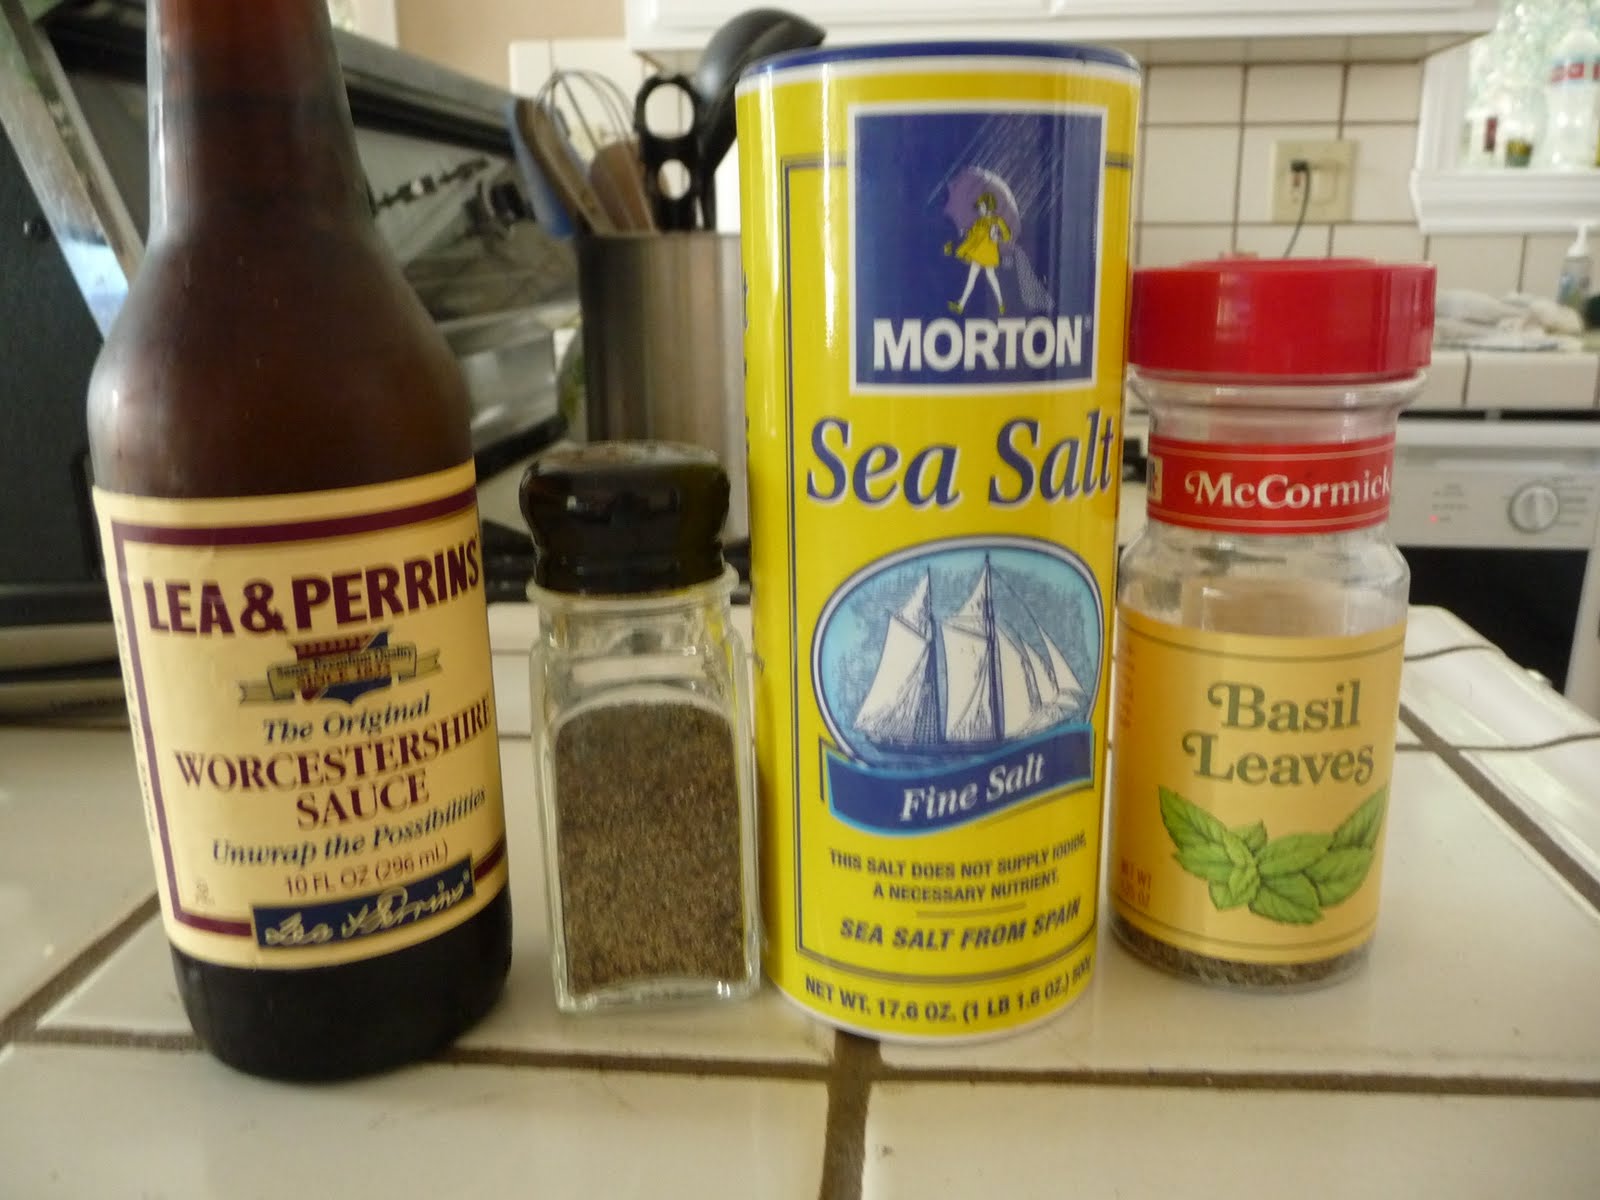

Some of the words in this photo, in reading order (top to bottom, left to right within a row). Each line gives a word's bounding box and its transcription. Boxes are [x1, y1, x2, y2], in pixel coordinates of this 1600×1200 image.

[872, 315, 1082, 371] MORTON
[806, 416, 961, 509] Sea
[988, 407, 1115, 507] Salt
[1184, 464, 1391, 510] McCormick
[143, 579, 235, 634] LEA
[240, 577, 286, 634] &
[291, 539, 480, 632] PERRINS
[262, 714, 314, 746] The
[323, 689, 431, 740] Original
[1207, 678, 1361, 733] Basil
[173, 693, 490, 793] WORCESTERSHIRE
[1181, 729, 1375, 786] Leaves
[296, 768, 430, 831] SAUCE
[899, 783, 978, 822] Fine
[986, 752, 1046, 800] Salt
[212, 839, 317, 868] Unwrap
[324, 834, 366, 858] the
[373, 784, 486, 848] Possibilities
[287, 874, 308, 897] 10
[313, 871, 335, 894] FL
[340, 864, 369, 887] OZ
[829, 848, 862, 871] THIS
[867, 853, 905, 877] SALT
[911, 860, 955, 879] DOES
[961, 858, 991, 878] NOT
[997, 848, 1050, 874] SUPPLY
[873, 884, 885, 899] A
[889, 885, 986, 904] NECESSARY
[840, 917, 884, 946] SEA
[892, 927, 955, 951] SALT
[961, 916, 1028, 951] FROM
[1032, 896, 1082, 938] SPAIN
[805, 974, 834, 1003] NET
[839, 987, 872, 1015] WT.
[987, 995, 1010, 1018] LB
